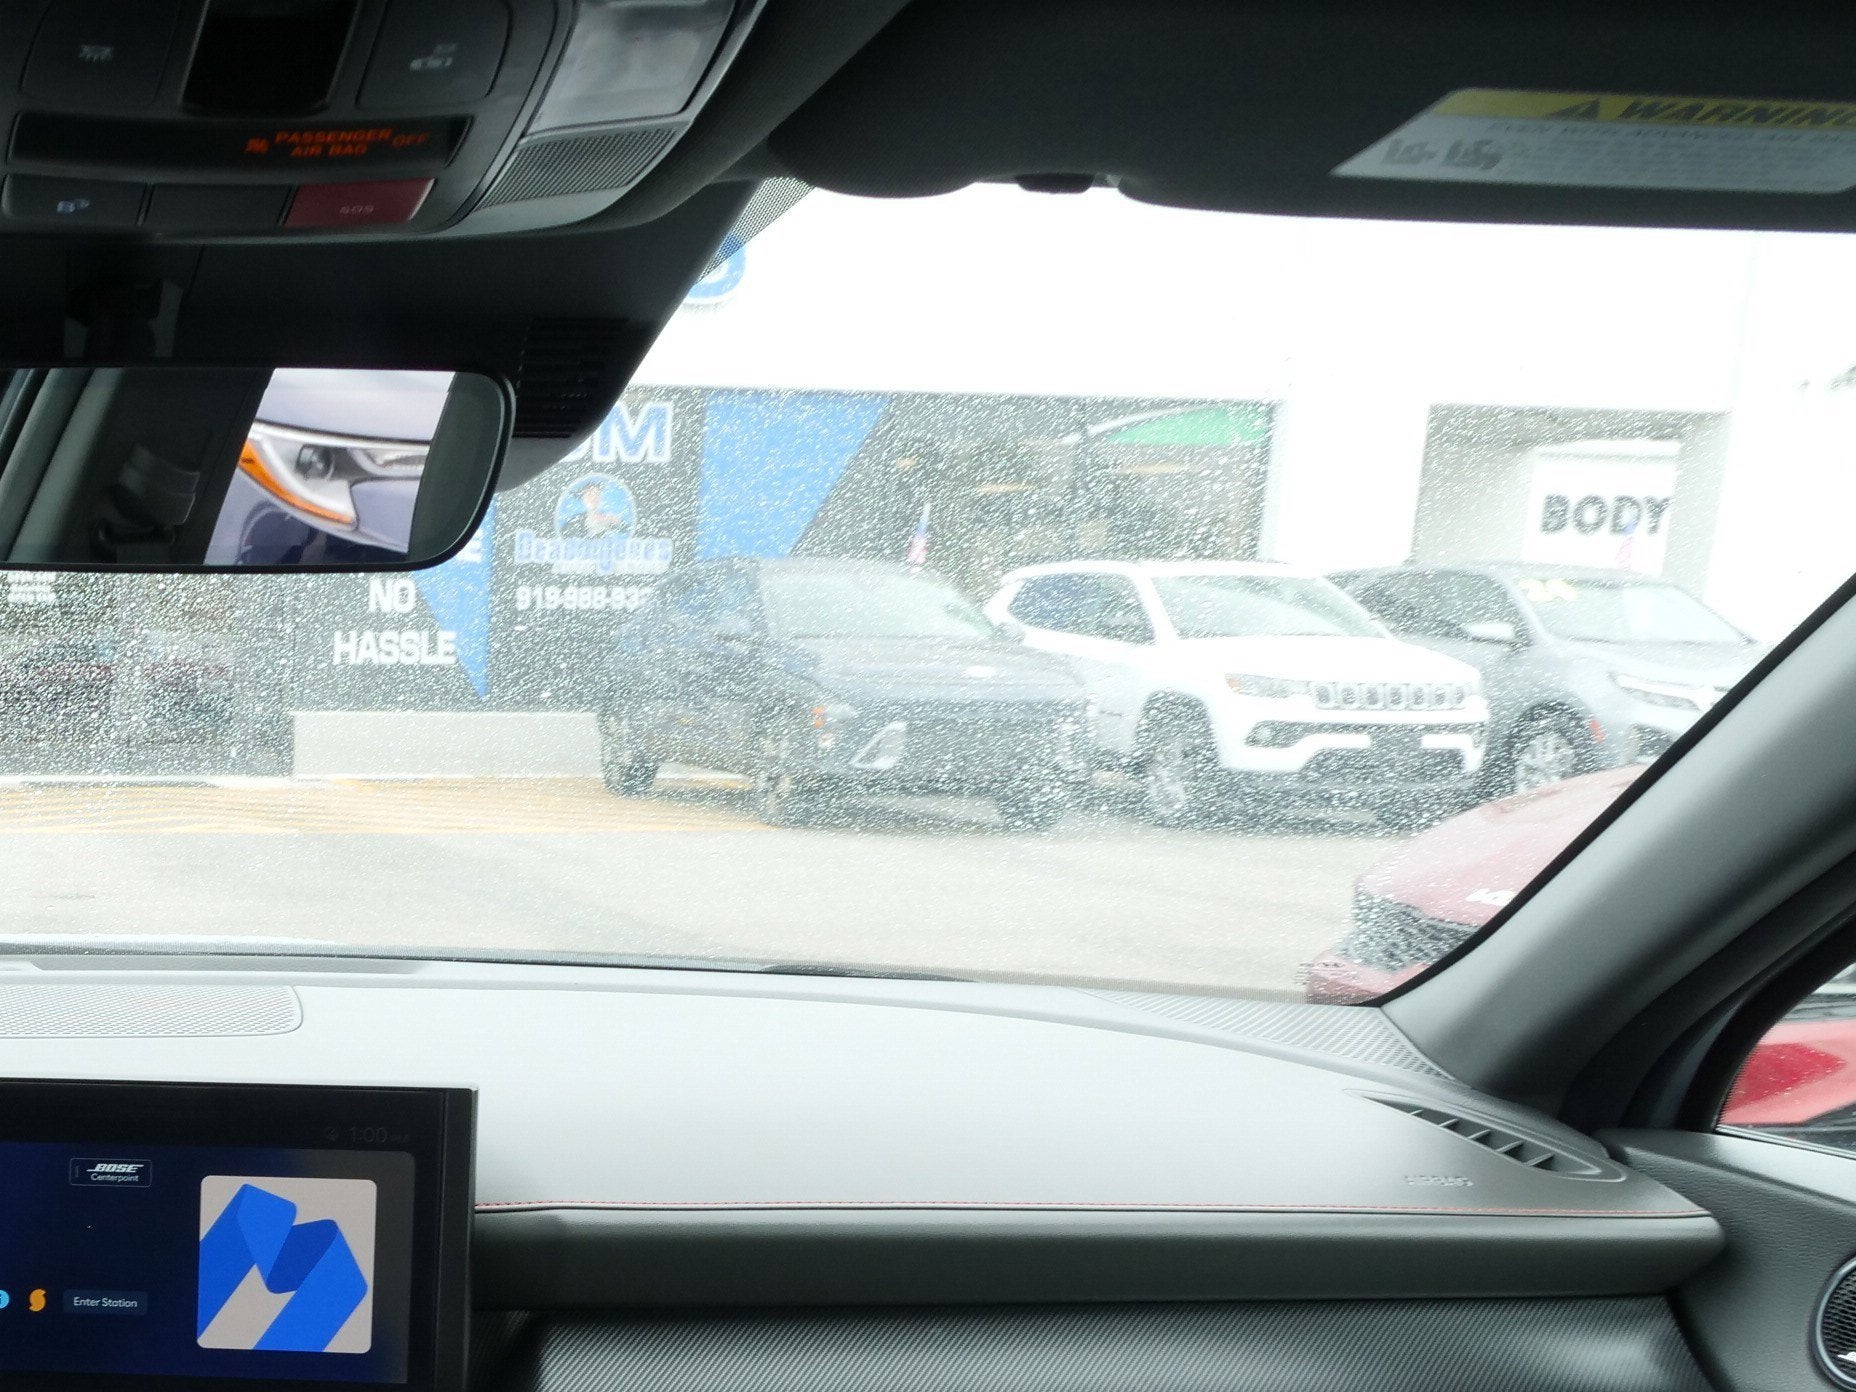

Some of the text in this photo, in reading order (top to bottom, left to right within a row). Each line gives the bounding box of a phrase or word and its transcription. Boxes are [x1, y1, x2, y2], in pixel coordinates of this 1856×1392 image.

[275, 129, 430, 147] PASSENGER OFF
[290, 144, 369, 157] AIR BAG
[339, 204, 374, 215] SOS
[1541, 494, 1672, 536] BODY
[367, 579, 416, 613] NO
[332, 631, 458, 665] HASSLE
[86, 1163, 144, 1173] BOSE
[90, 1173, 139, 1182] Centerpoint
[73, 1297, 138, 1308] Enter Station
